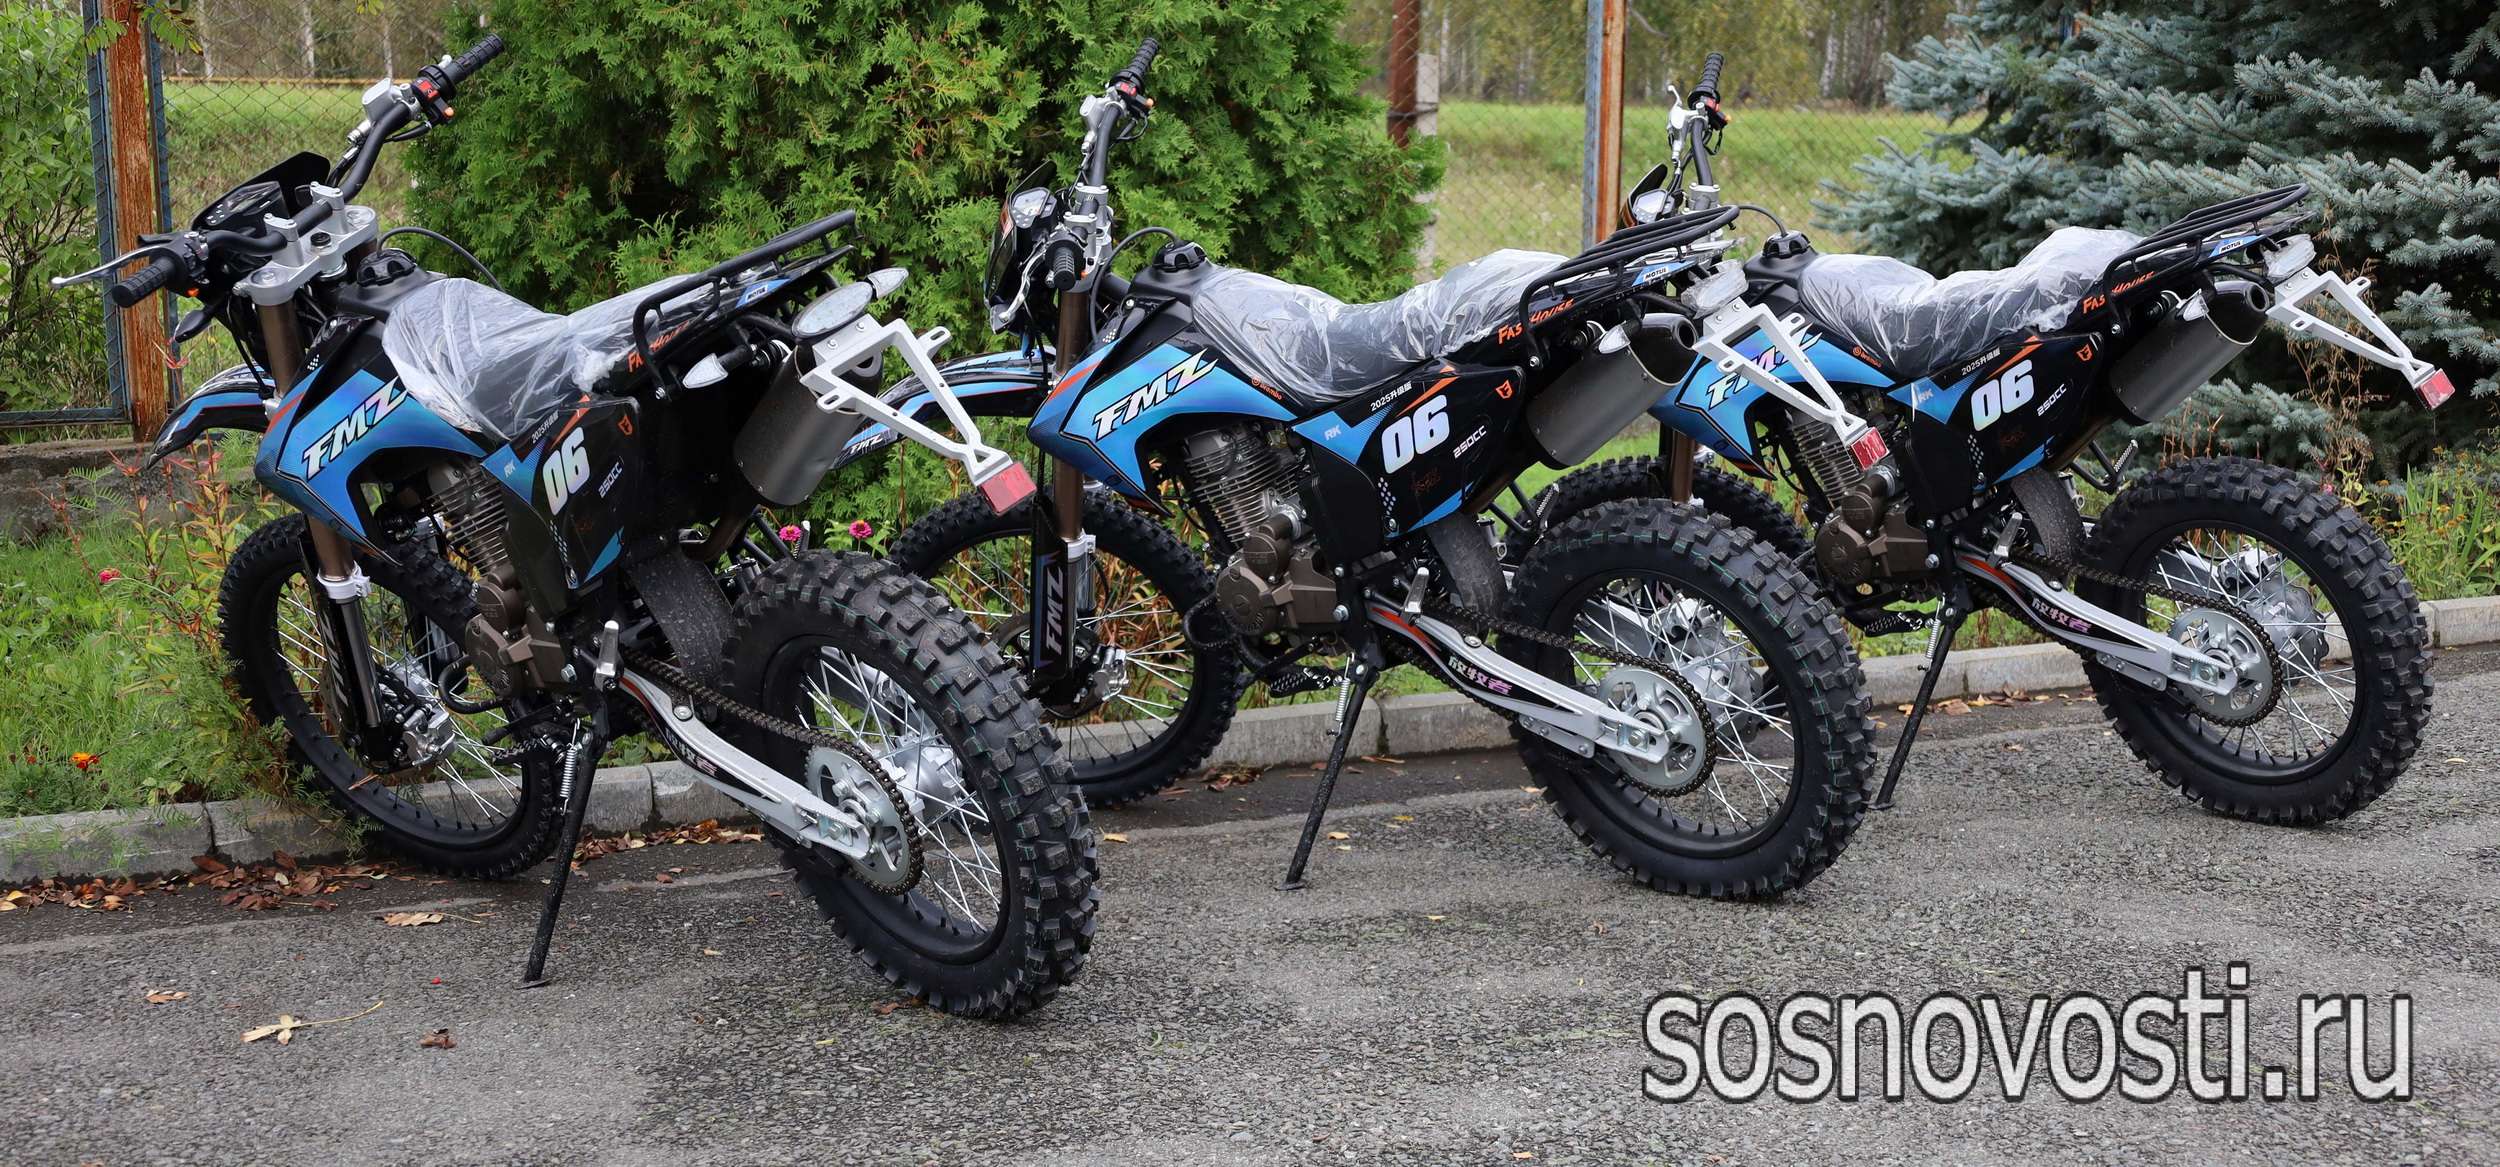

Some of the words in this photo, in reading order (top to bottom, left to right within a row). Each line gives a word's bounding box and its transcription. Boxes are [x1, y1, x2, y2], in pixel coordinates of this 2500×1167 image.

[1092, 347, 1219, 443] FMZ
[1918, 388, 1934, 403] RK
[1971, 359, 2034, 432] 06
[2036, 383, 2067, 417] 250CC
[302, 374, 408, 482] FMZ
[1324, 424, 1342, 441] RK
[1381, 394, 1451, 475] 06
[1452, 425, 1487, 459] 250CC
[503, 458, 516, 478] RK
[542, 426, 590, 516] 06
[598, 461, 623, 499] 250CC
[1046, 566, 1064, 656] FMZ
